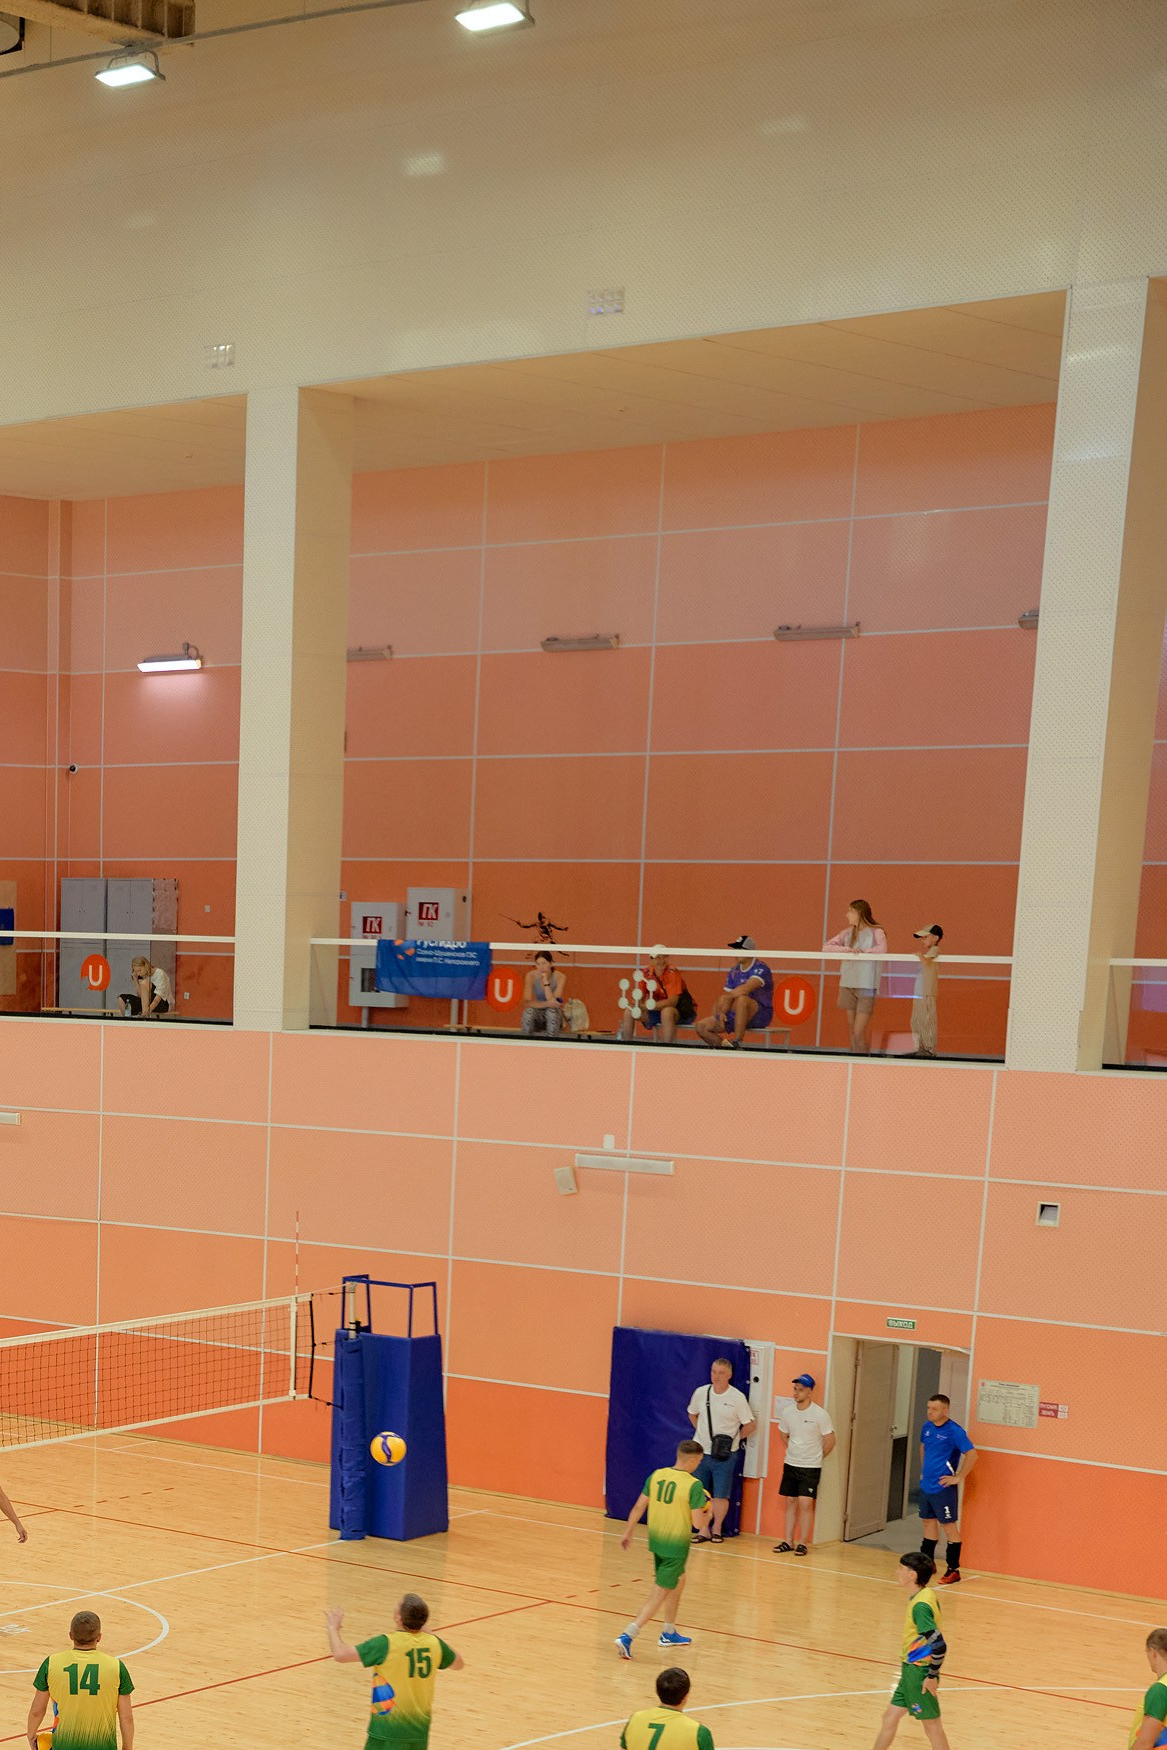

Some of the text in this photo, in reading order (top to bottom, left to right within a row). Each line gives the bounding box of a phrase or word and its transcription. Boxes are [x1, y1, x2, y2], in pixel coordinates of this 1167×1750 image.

[888, 1319, 914, 1330] ВЫХОД
[656, 1479, 677, 1504] 10
[405, 1647, 432, 1678] 15
[63, 1663, 101, 1695] 14
